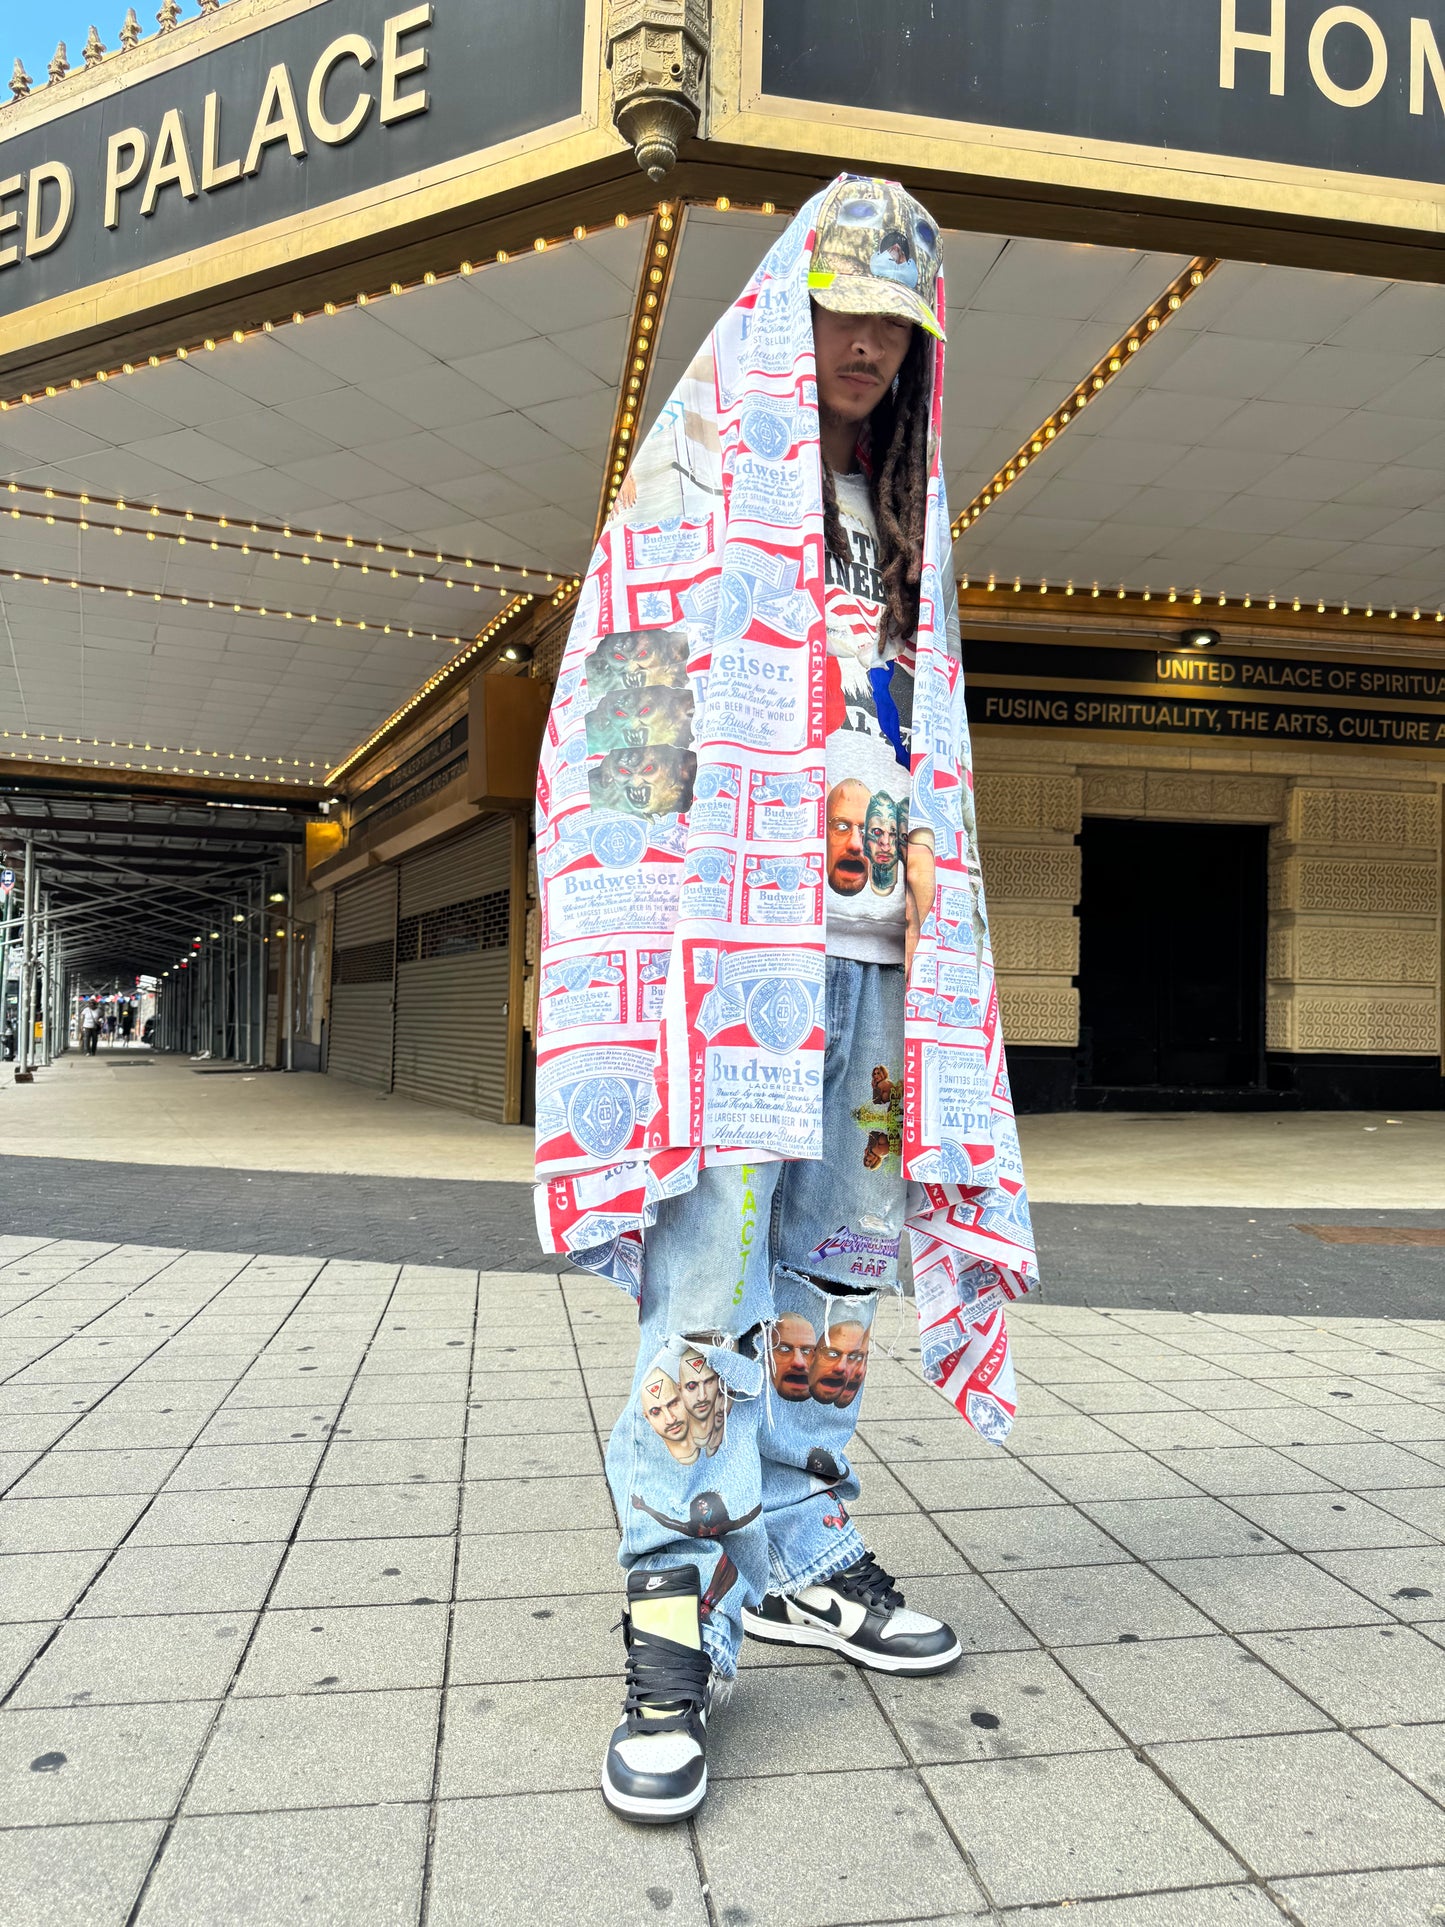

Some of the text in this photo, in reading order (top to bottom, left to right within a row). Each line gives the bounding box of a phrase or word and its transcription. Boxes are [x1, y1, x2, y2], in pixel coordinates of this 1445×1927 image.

[104, 2, 434, 229] PALACE
[601, 572, 610, 632] GENUINE
[1157, 658, 1235, 682] UNITED
[1242, 665, 1323, 688] PALACE
[1328, 670, 1356, 690] OF
[812, 640, 823, 742] GENUINE
[767, 711, 795, 722] WORLD
[986, 697, 1069, 721] FUSING
[1073, 704, 1221, 731] SPIRITUALITY,
[1227, 710, 1269, 731] THE
[1274, 714, 1334, 739] ARTS,
[1338, 716, 1430, 741] CULTURE
[564, 868, 680, 895] Budweiser.
[712, 1053, 820, 1086] Budweis
[906, 1044, 916, 1143] GENUINE
[715, 1112, 746, 1123] LARGEST
[750, 1113, 780, 1125] SELLING
[799, 1118, 809, 1128] IN
[555, 1179, 569, 1211] GE
